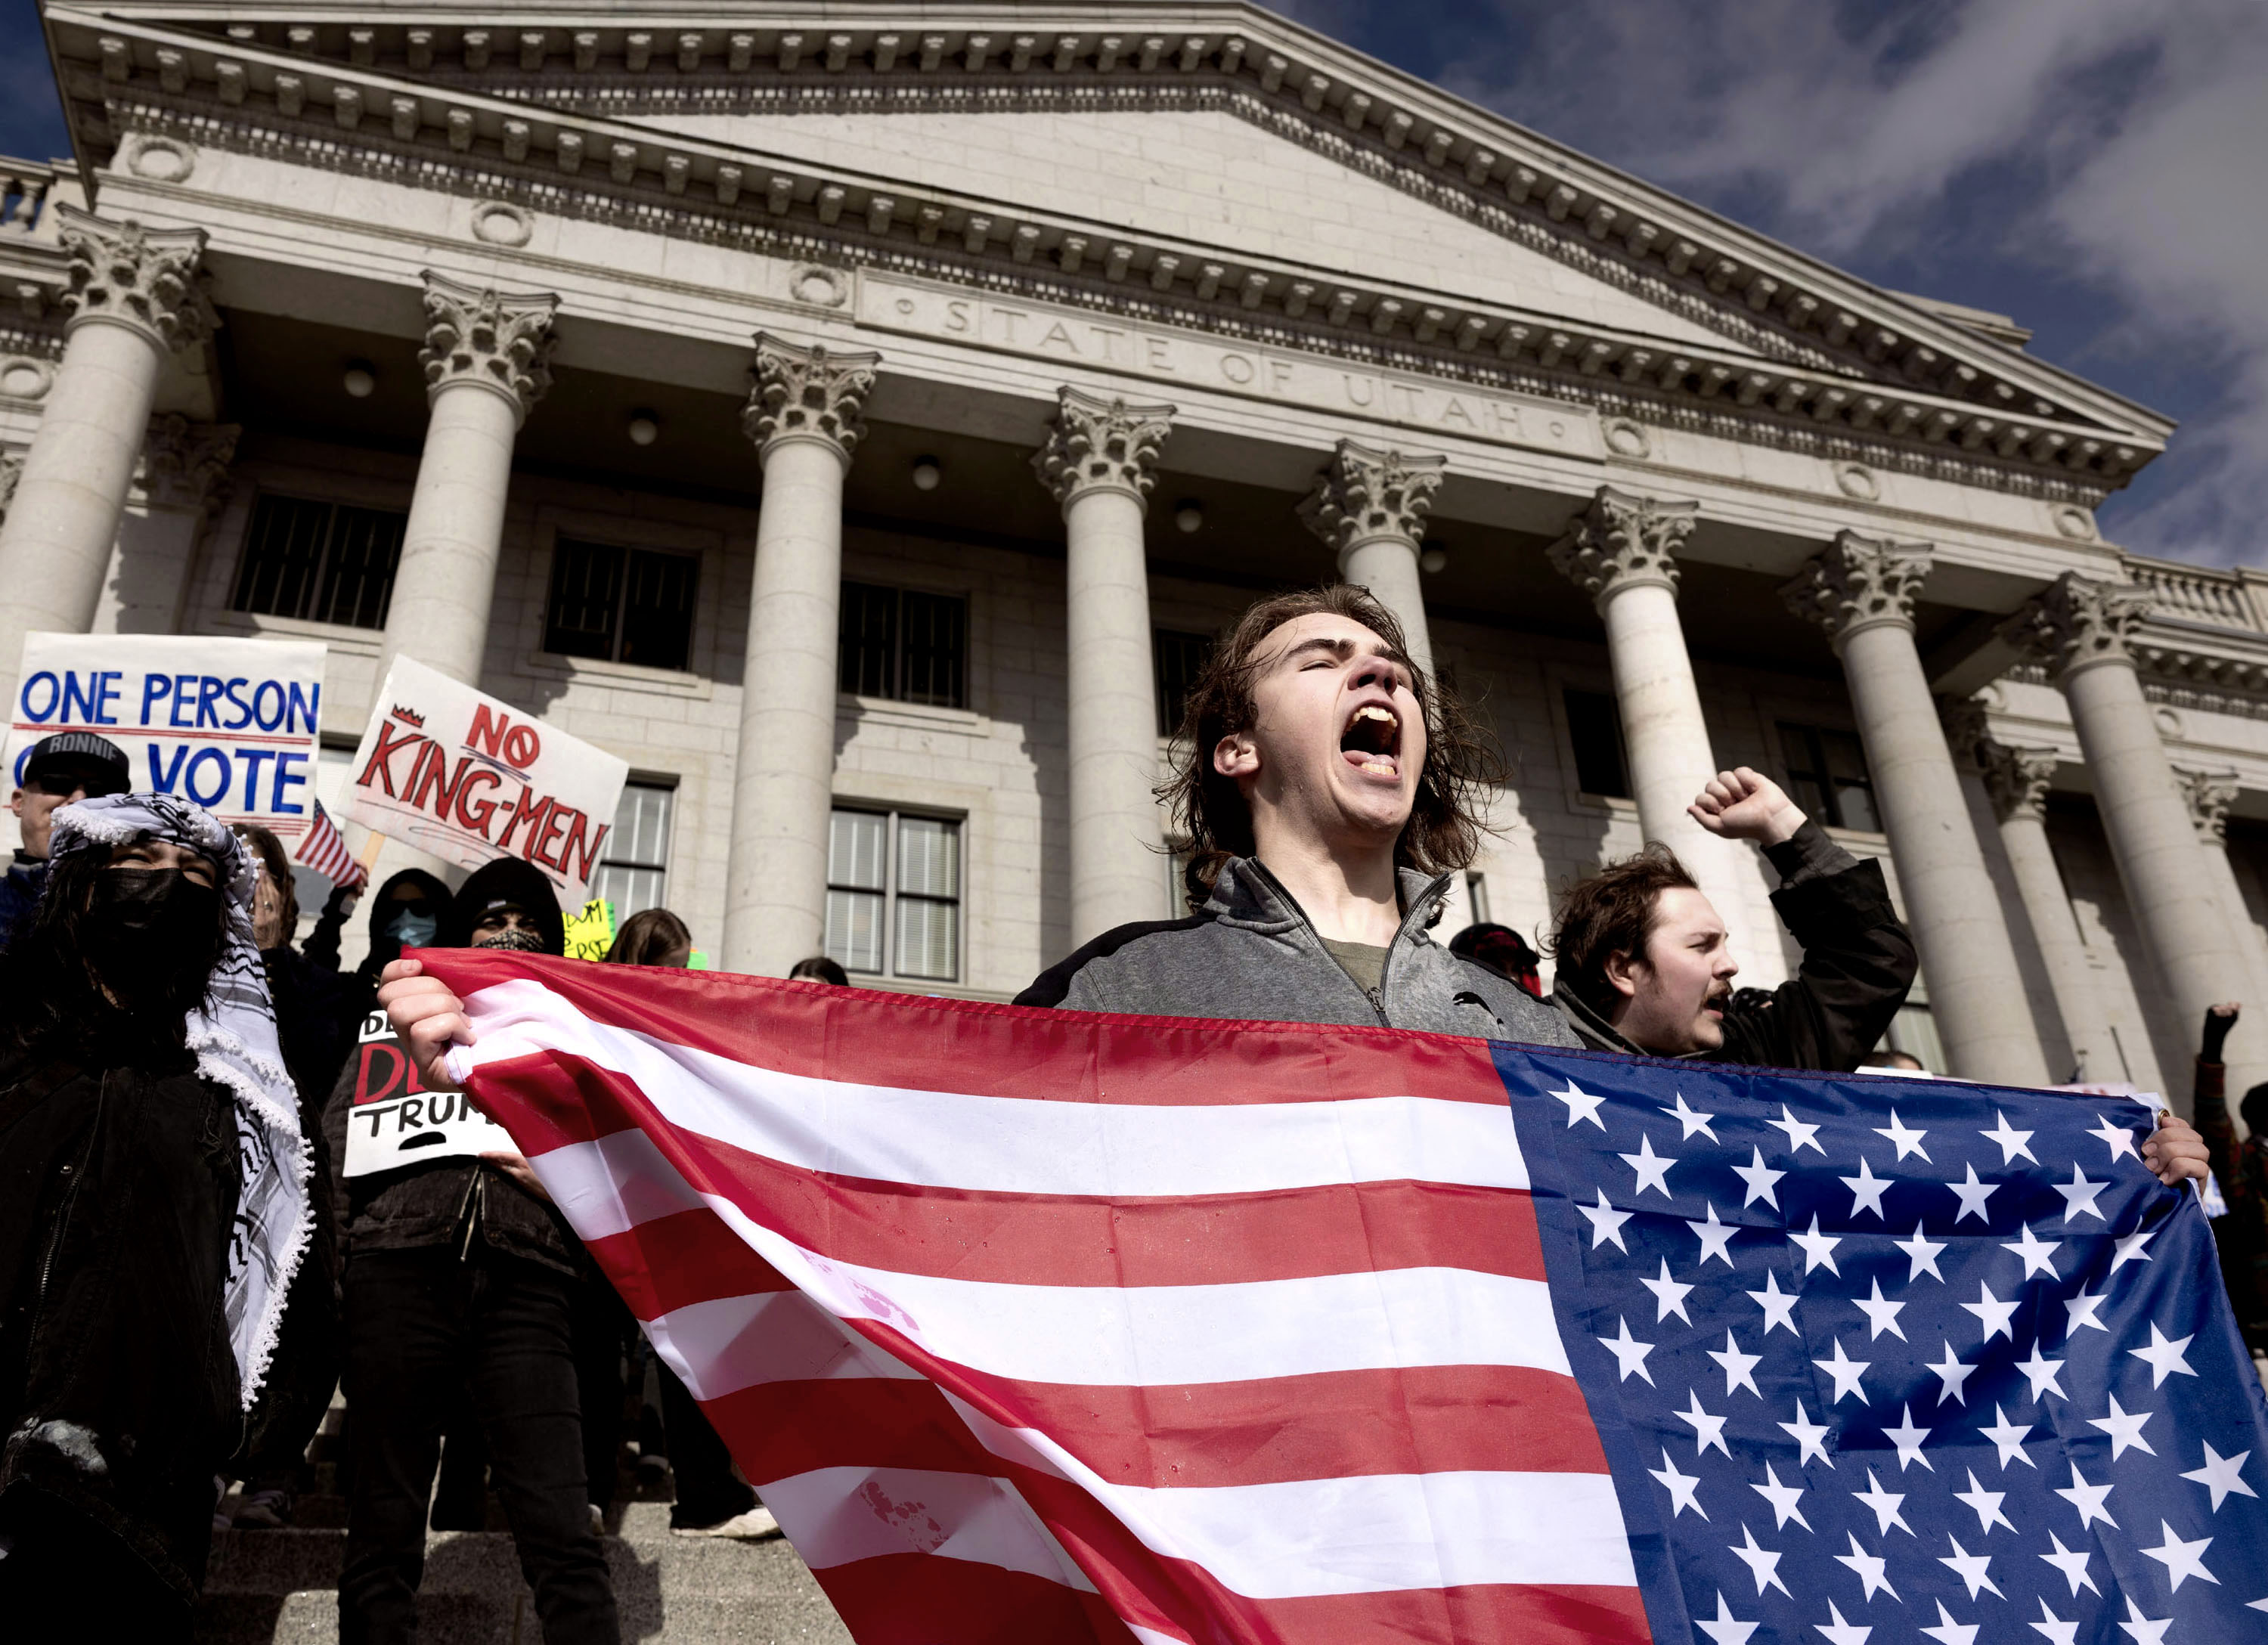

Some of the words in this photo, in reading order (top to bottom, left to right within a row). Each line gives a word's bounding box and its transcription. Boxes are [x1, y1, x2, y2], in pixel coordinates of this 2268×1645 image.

[946, 301, 1174, 371] STATE
[1219, 353, 1294, 392] OF
[1343, 376, 1526, 438] UTAH
[21, 671, 122, 725] ONE
[141, 674, 320, 734] PERSON
[465, 703, 540, 769] NO
[147, 743, 309, 814] VOTE
[356, 720, 610, 887] KING-MEN
